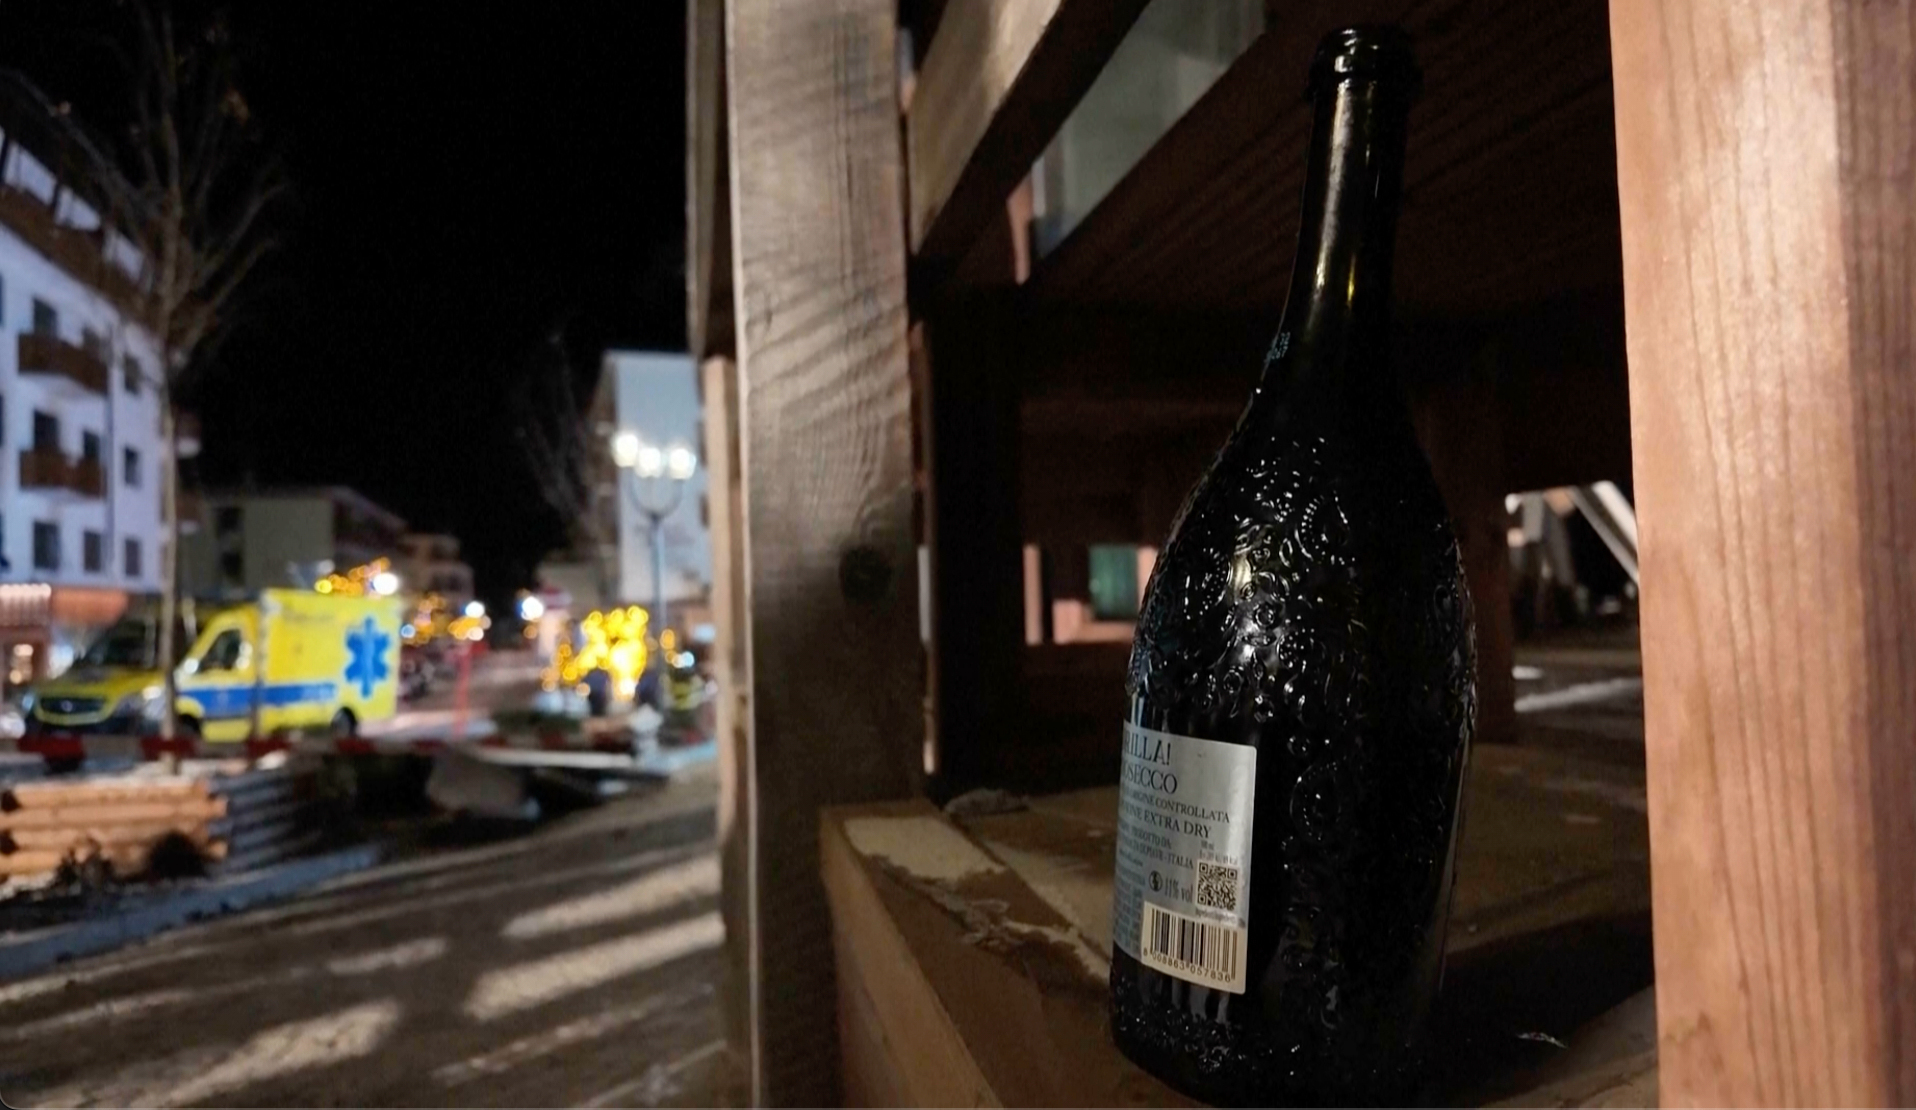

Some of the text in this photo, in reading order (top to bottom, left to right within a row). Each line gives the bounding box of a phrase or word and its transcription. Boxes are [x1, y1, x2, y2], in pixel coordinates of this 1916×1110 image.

[1155, 797, 1230, 823] CONTROLLATA
[1144, 809, 1180, 832] EXTRA
[1184, 820, 1212, 839] DRY
[1168, 853, 1194, 869] ITALIA
[1181, 884, 1193, 904] vol
[1189, 964, 1231, 983] 057836
